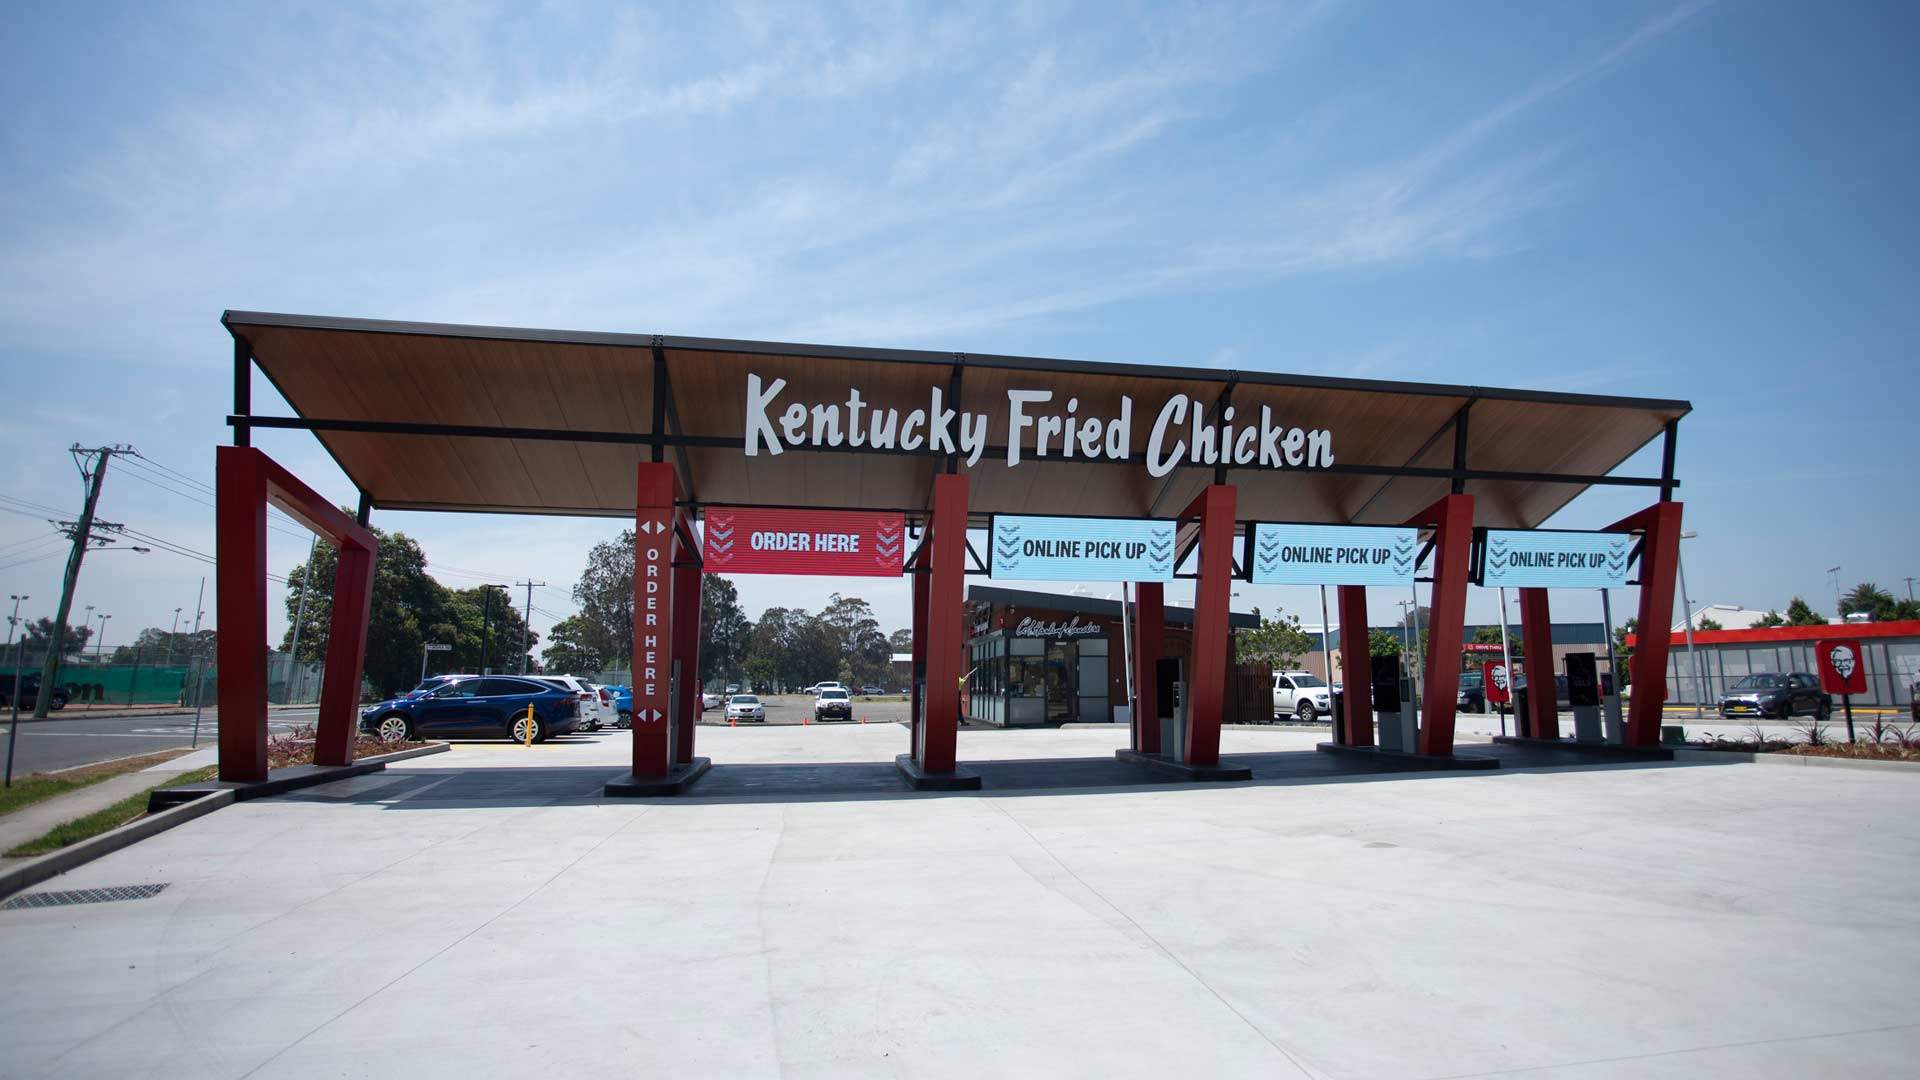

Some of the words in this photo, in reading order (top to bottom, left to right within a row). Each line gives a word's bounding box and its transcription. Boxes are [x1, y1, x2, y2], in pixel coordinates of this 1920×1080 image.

[744, 373, 988, 469] Kentucky
[1006, 389, 1132, 469] Fried
[1146, 394, 1335, 478] Chicken
[750, 531, 811, 552] ORDER
[814, 533, 860, 553] HERE
[1023, 539, 1081, 558] ONLINE
[1084, 541, 1122, 559] PICK
[1125, 542, 1147, 561] UP
[1281, 546, 1333, 563] ONLINE
[1336, 547, 1369, 564] PICK
[1372, 548, 1391, 565] UP
[1509, 551, 1555, 568] ONLINE
[1557, 552, 1586, 568] PICK
[1589, 553, 1606, 568] UP
[646, 548, 659, 626] ORDER
[645, 635, 657, 696] HERE
